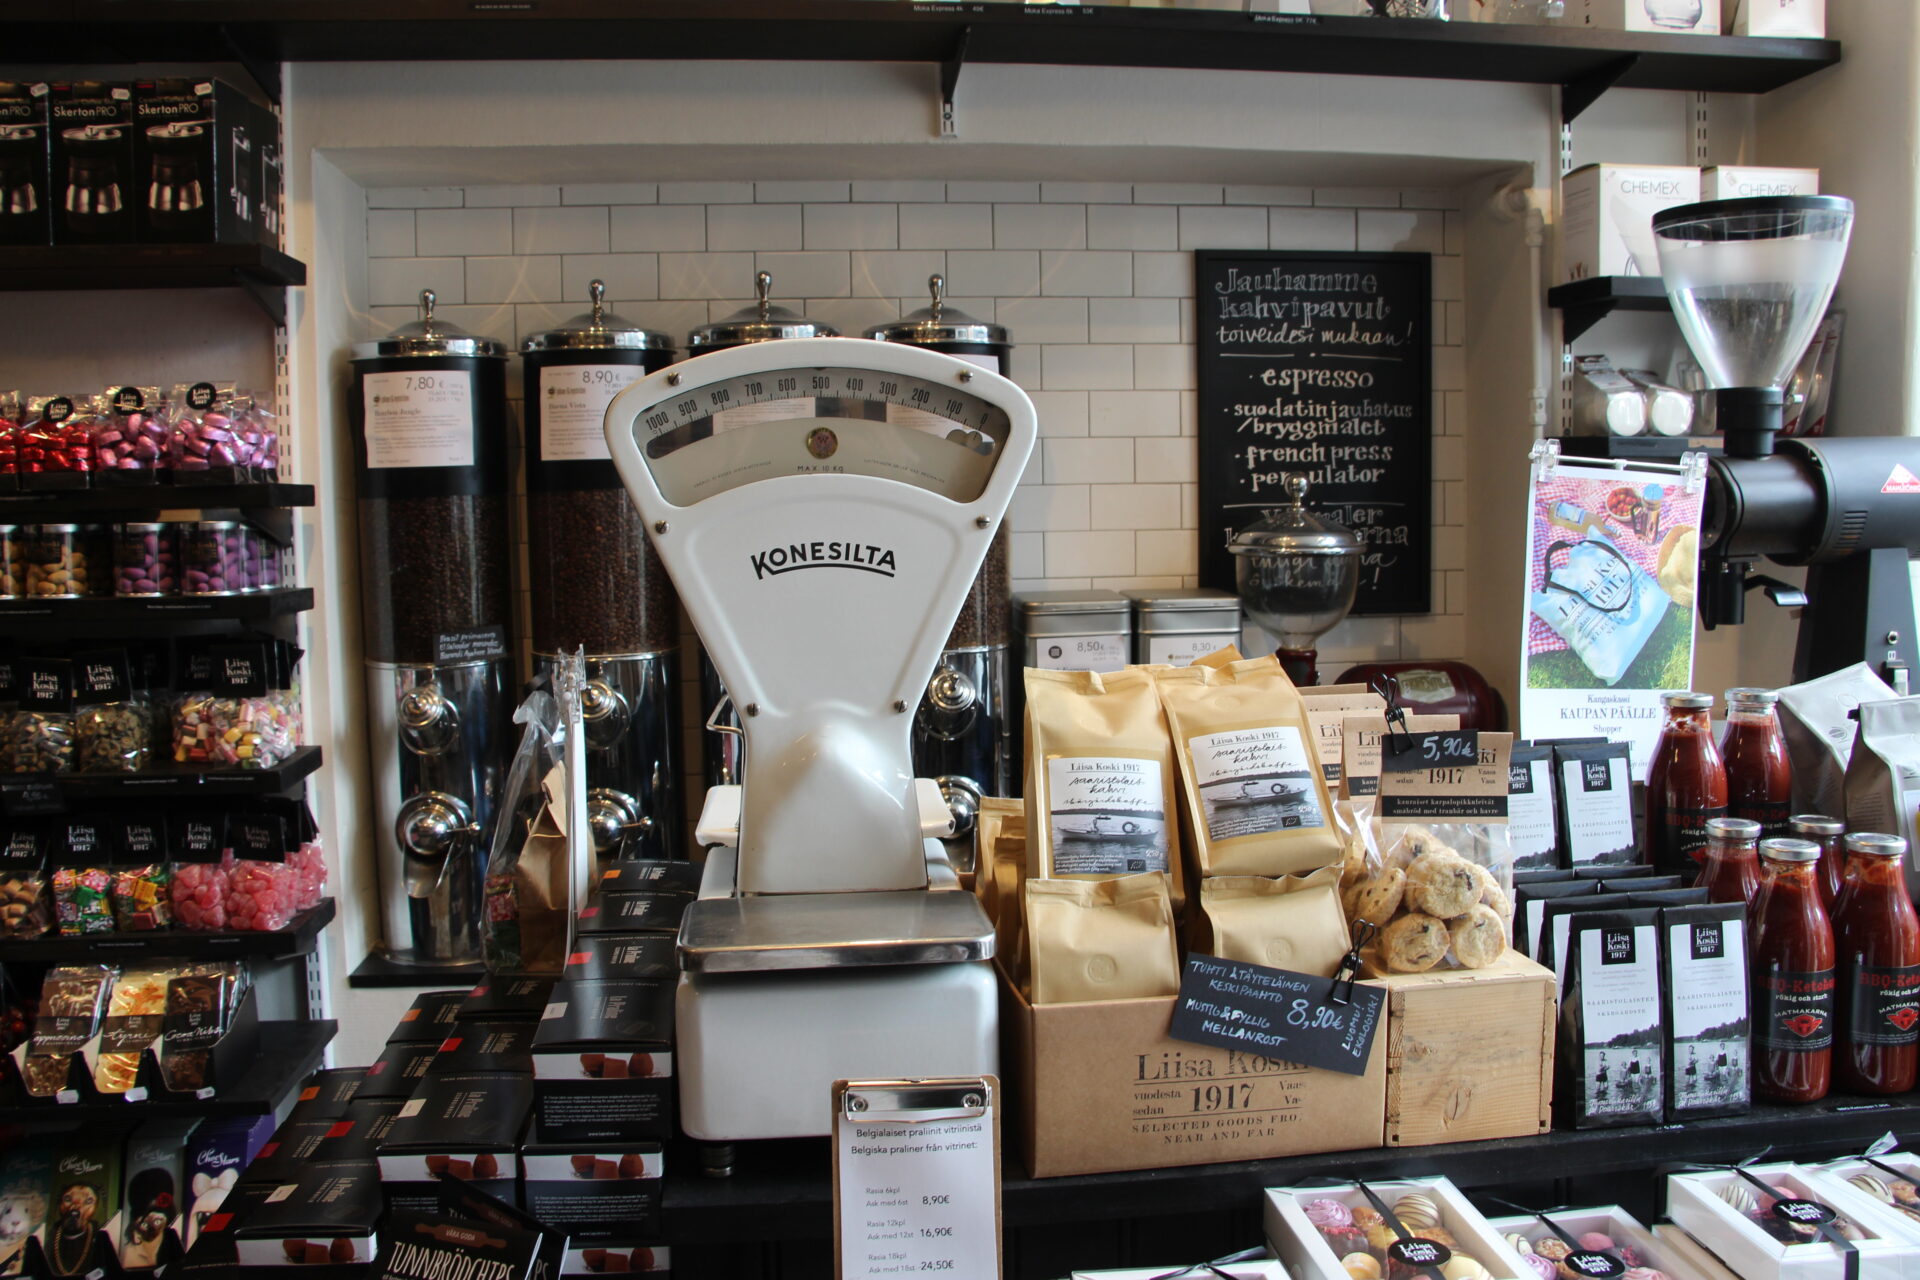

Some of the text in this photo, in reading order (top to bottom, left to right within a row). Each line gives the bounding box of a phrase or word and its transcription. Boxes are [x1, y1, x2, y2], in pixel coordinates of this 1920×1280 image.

[1620, 180, 1680, 195] CHEMEX
[1738, 183, 1798, 197] CHEMEX
[1215, 267, 1377, 294] Jauhamme
[1218, 295, 1391, 328] kahvipavut
[1216, 322, 1315, 344] toiveidesi
[404, 377, 434, 391] 7,80
[582, 370, 613, 385] 8,90
[812, 376, 830, 390] 500
[1261, 368, 1374, 395] espresso
[744, 382, 763, 397] 700
[777, 377, 797, 393] 600
[846, 377, 864, 392] 400
[879, 380, 898, 396] 300
[711, 389, 731, 405] 800
[911, 387, 931, 405] 200
[678, 400, 698, 416] 900
[945, 399, 963, 416] 100
[1233, 398, 1413, 422] suodatinjauhatus
[645, 411, 670, 431] 1000
[980, 413, 989, 425] 0
[1245, 442, 1393, 469] french press
[1251, 465, 1386, 492] perulator
[750, 542, 896, 580] KONESILTA
[87, 665, 113, 675] Liisa
[225, 659, 250, 668] Liisa
[32, 672, 58, 682] Liisa
[88, 674, 114, 682] Koski
[225, 667, 251, 676] Koski
[32, 682, 58, 690] Koski
[94, 682, 112, 691] 1917
[36, 691, 54, 699] 1917
[1560, 706, 1657, 719] KAUPAN PÄÄLLE
[1593, 724, 1622, 734] Shopper
[1211, 732, 1279, 746] Liisa Koski 1917
[1423, 735, 1475, 761] 5,90€
[1071, 762, 1141, 771] Liisa Koski 1917
[1427, 768, 1465, 784] 1917
[1397, 798, 1429, 806] kauraiset
[1393, 806, 1422, 815] småbröd
[1438, 806, 1464, 814] tranbär
[1466, 806, 1478, 814] och
[68, 826, 95, 834] Liisa
[68, 833, 96, 843] Koski
[72, 844, 91, 852] 1917
[1607, 933, 1629, 943] Liisa
[1696, 928, 1718, 938] Liisa
[1607, 941, 1630, 951] Koski
[1696, 936, 1719, 945] Koski
[1190, 960, 1228, 978] TUHTI
[1798, 994, 1812, 1002] och
[1812, 993, 1828, 1001] stark
[1286, 999, 1345, 1030] 8,90€
[1774, 1008, 1828, 1018] MATMAKARNA
[1201, 1020, 1288, 1047] MELLANROST
[1135, 1052, 1215, 1081] Liisa
[1134, 1082, 1255, 1113] vuodesta 1917
[1132, 1106, 1164, 1116] sedan
[1132, 1121, 1210, 1133] SELECTED
[1216, 1116, 1264, 1127] GOODS
[856, 1125, 982, 1138] Belgialaiset praliinit vitriinistä
[1164, 1128, 1275, 1144] NEAR AND FAR
[851, 1142, 978, 1156] Belgiska praliner från vitrinet:
[886, 1187, 900, 1196] 6kpl
[922, 1194, 950, 1206] 8,90€
[887, 1220, 906, 1228] 12kpl
[446, 1228, 476, 1241] VÅRA GODA
[882, 1232, 898, 1240] med
[920, 1227, 952, 1239] 16,90€
[1398, 1244, 1431, 1254] Liisa
[1403, 1249, 1439, 1258] Koski
[387, 1241, 516, 1280] TUNNBRÖDCHIPS
[1412, 1254, 1436, 1262] 1917
[1572, 1254, 1603, 1264] Liisa
[1577, 1260, 1612, 1269] Koski
[869, 1266, 881, 1274] Ask
[920, 1260, 954, 1272] 24,50€
